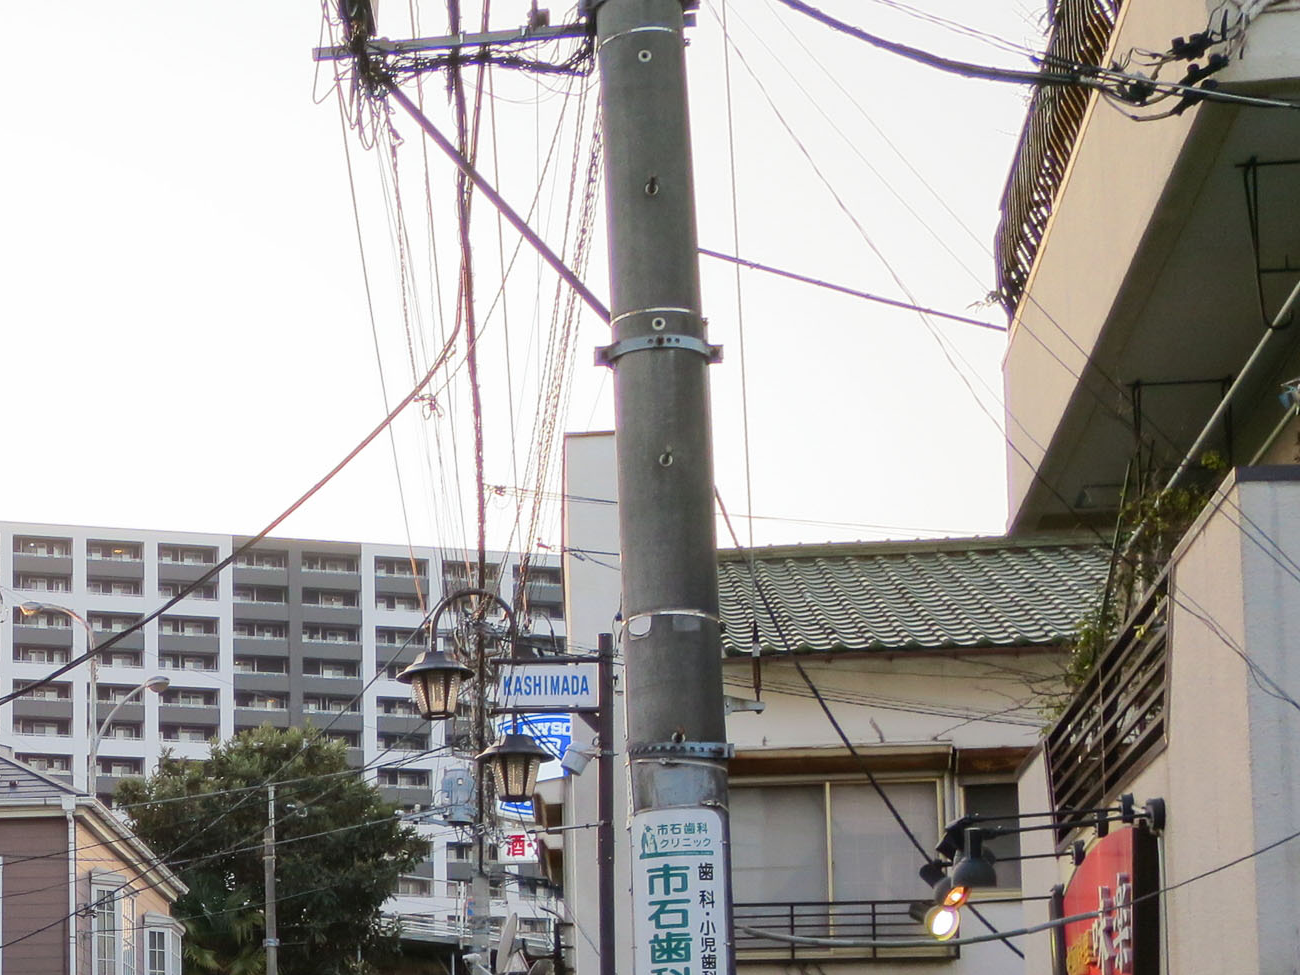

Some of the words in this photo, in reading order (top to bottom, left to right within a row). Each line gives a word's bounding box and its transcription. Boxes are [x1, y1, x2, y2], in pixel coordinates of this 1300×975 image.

[503, 675, 589, 697] KASHIMADA
[657, 822, 708, 836] 市石歯科
[659, 837, 712, 849] クリニック
